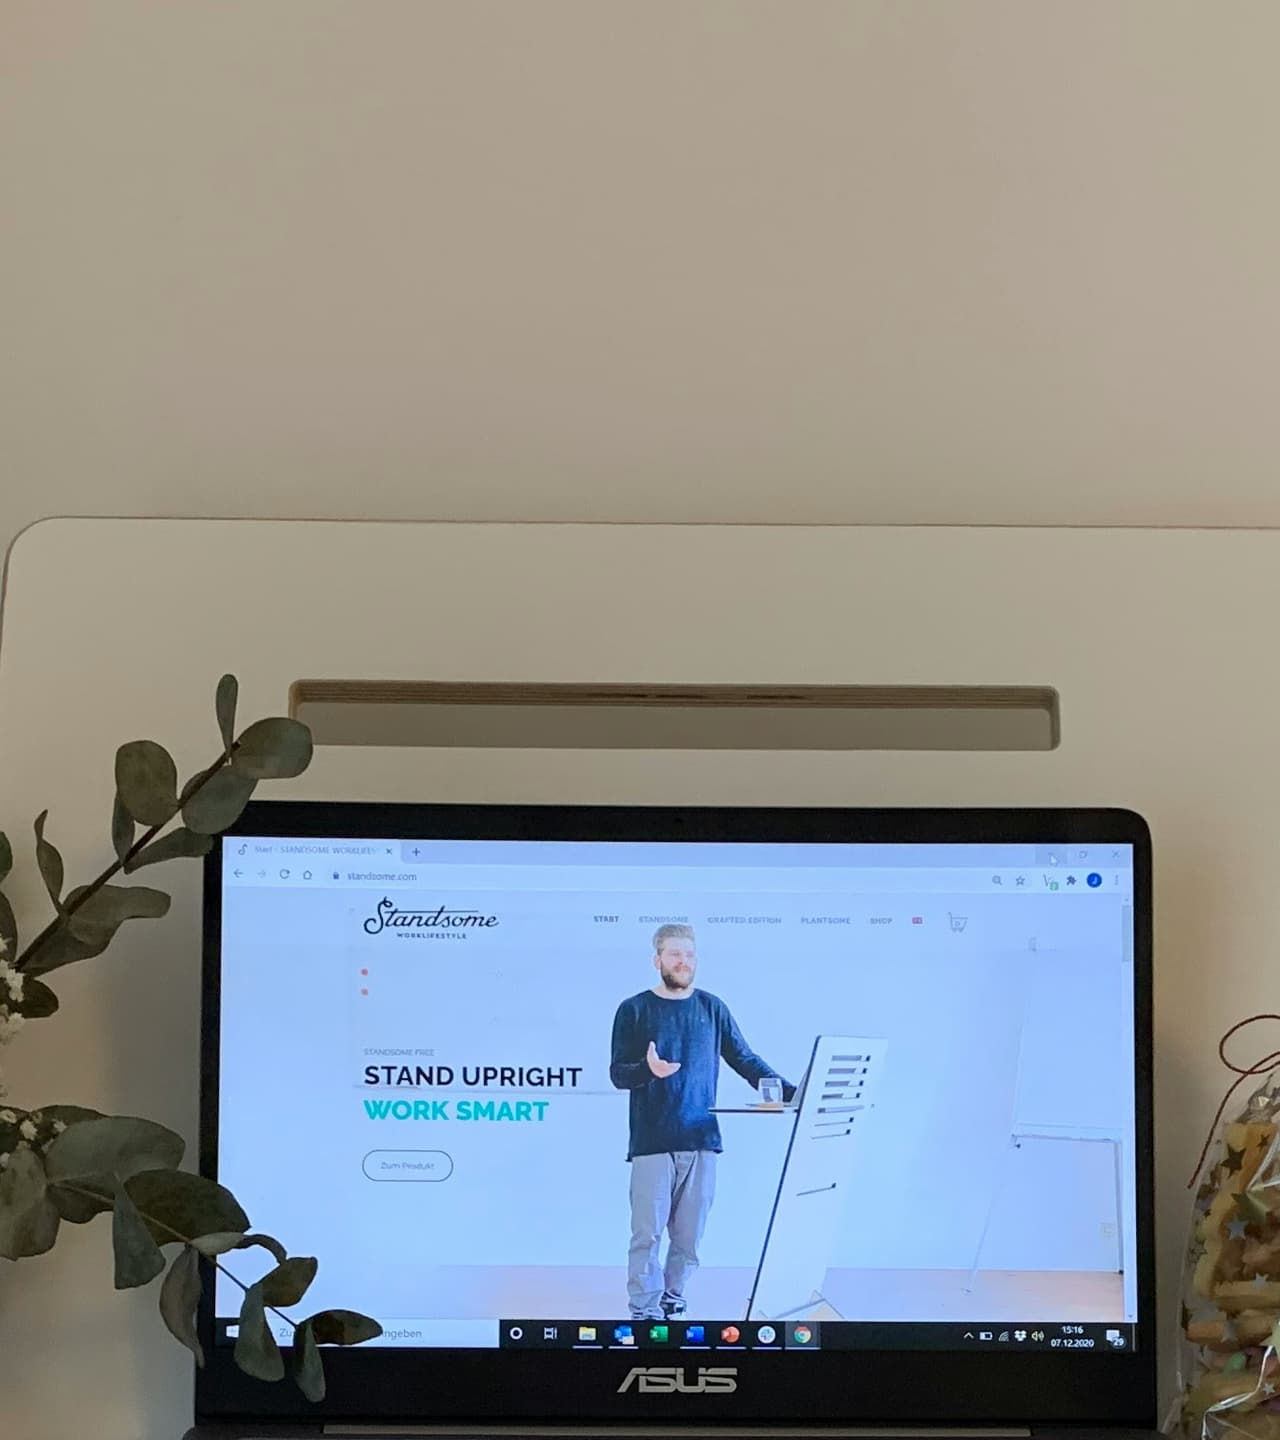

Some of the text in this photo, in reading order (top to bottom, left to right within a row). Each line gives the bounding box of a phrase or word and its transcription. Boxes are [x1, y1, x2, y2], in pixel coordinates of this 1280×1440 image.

[347, 871, 417, 881] standsome.com
[363, 896, 499, 934] Standsome
[593, 915, 619, 923] START
[870, 917, 893, 925] SHOP
[396, 932, 467, 940] WORKLIFESTYLE
[364, 1048, 435, 1057] STANDSOME FREE
[364, 1065, 583, 1088] STAND UPRIGHT
[363, 1100, 550, 1122] WORK SMART
[380, 1161, 401, 1170] Zum
[1061, 1325, 1084, 1335] 15:16
[1050, 1338, 1095, 1348] 07.12.2020
[617, 1367, 738, 1393] ASUS
